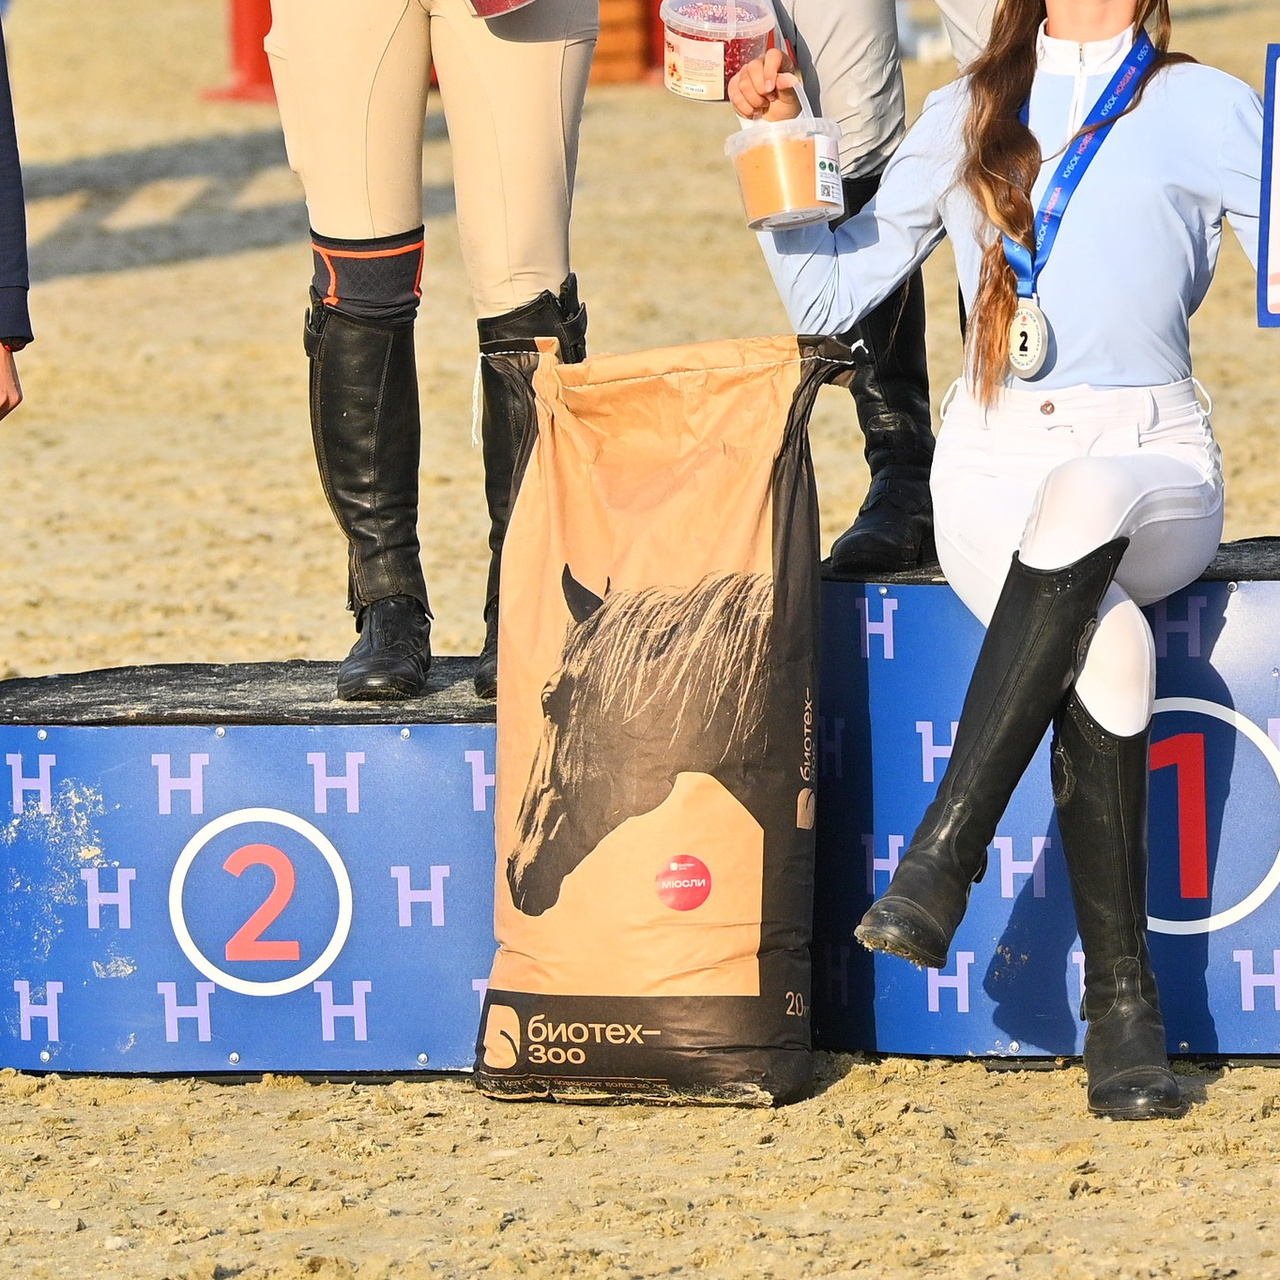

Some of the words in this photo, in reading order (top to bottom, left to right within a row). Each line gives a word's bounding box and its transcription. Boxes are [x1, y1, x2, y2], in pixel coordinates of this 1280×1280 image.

[1100, 95, 1117, 117] КУБОК
[1115, 65, 1137, 96] HORSEKA
[1062, 153, 1081, 179] КУБОК
[1035, 223, 1048, 251] КУБОК
[1043, 187, 1063, 223] HORSEKA
[1019, 331, 1029, 352] 2
[1149, 732, 1208, 899] 1
[222, 843, 300, 961] 2
[785, 991, 804, 1016] 20
[527, 1014, 661, 1045] биотех-
